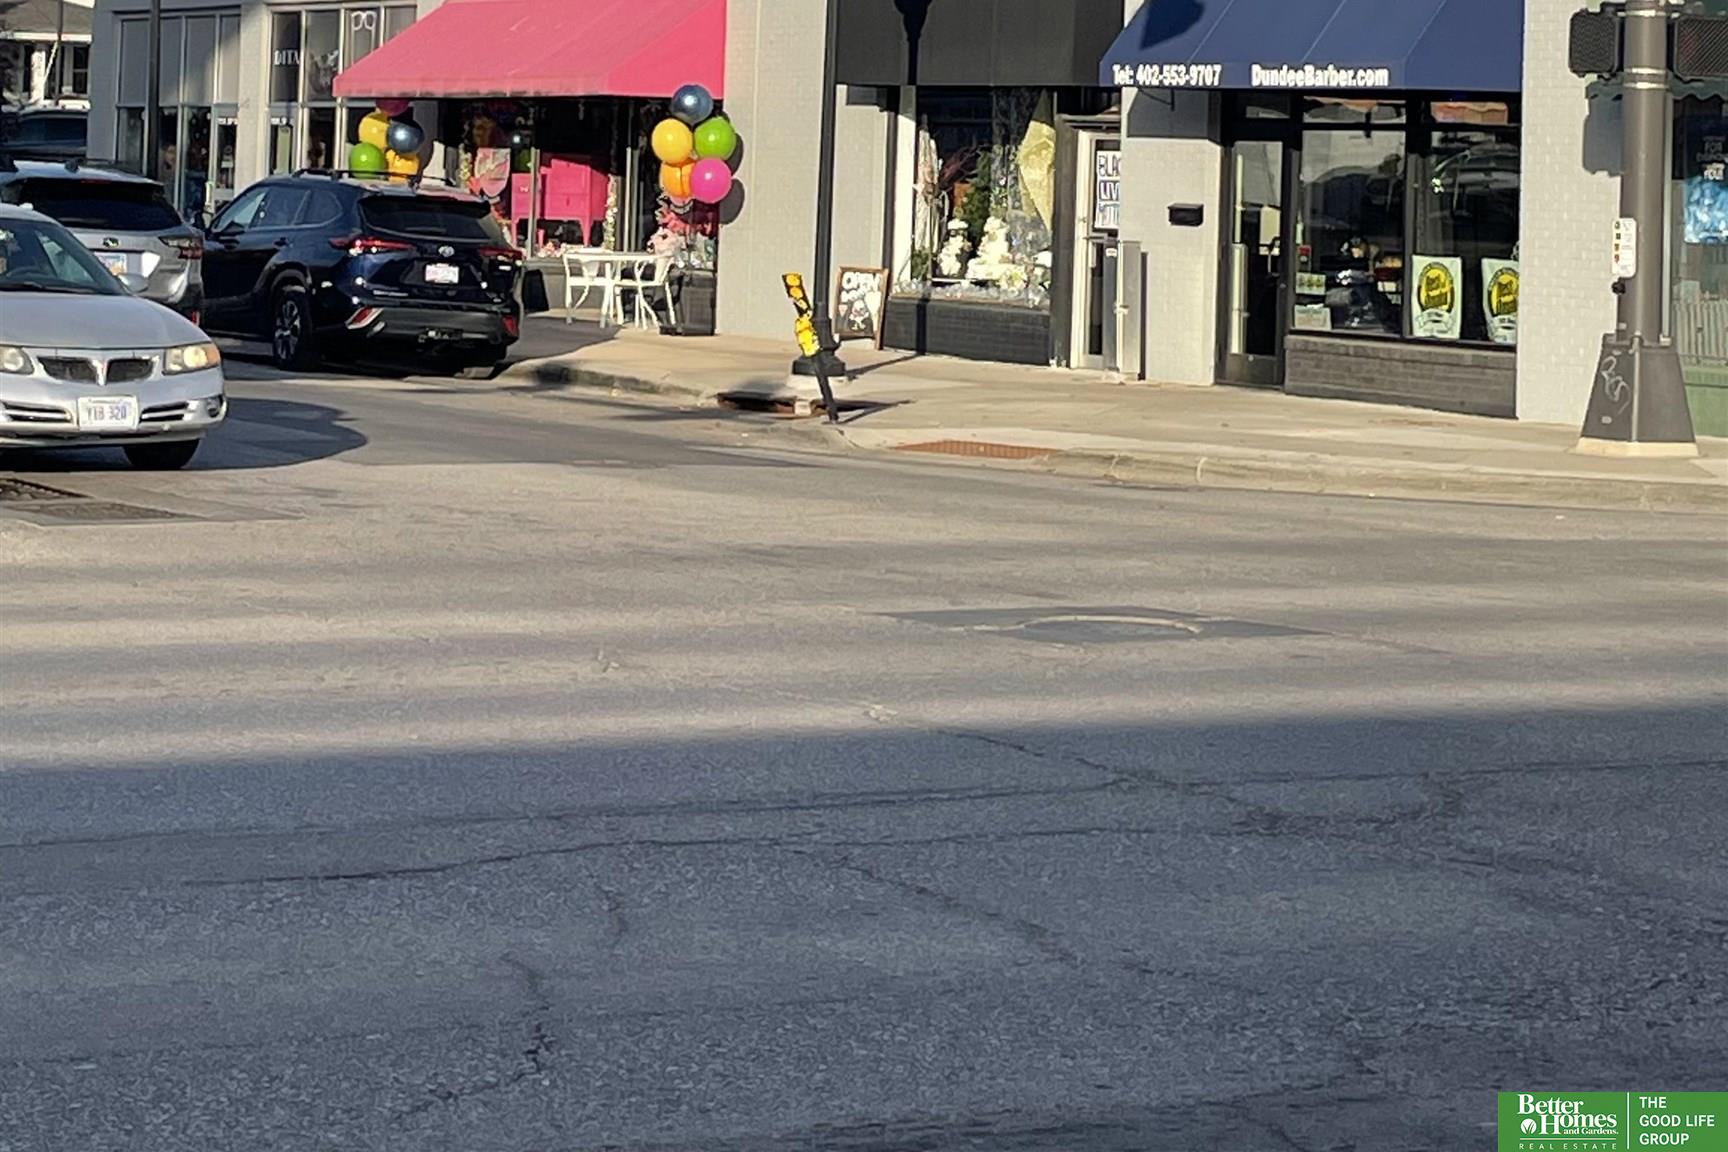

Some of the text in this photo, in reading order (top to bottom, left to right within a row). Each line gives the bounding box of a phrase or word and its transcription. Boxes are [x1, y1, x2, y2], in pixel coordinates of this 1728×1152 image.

[1112, 64, 1222, 86] Tel: 402-553-9707
[1252, 64, 1389, 87] DundeeBarber.com
[1099, 154, 1120, 176] BLA
[1099, 180, 1120, 201] LIV
